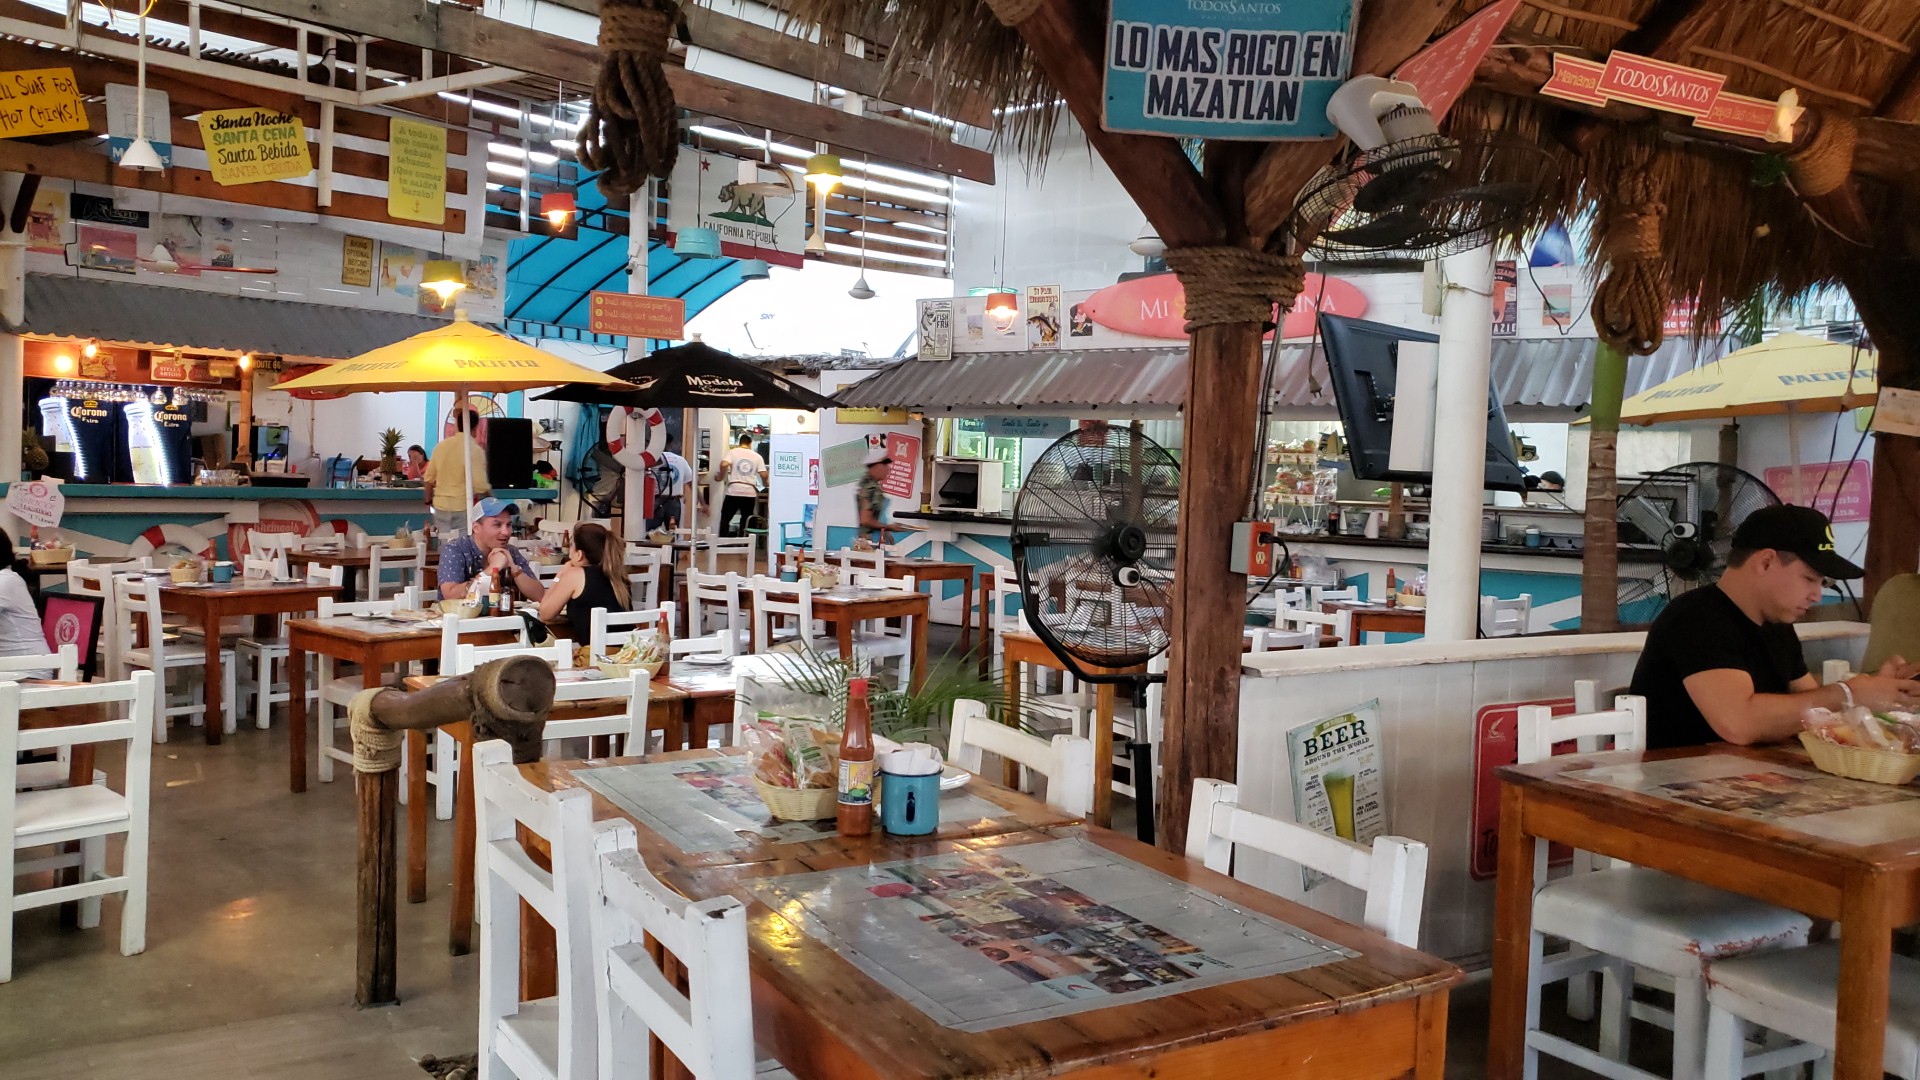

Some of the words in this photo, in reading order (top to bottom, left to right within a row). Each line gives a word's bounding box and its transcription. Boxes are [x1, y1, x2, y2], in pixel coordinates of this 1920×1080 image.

[1114, 24, 1149, 69] LO
[1156, 28, 1221, 75] MAS
[1226, 33, 1297, 77] RICO
[1302, 35, 1343, 77] EN
[1146, 75, 1300, 121] MAZATLAN
[210, 114, 252, 131] Santa
[253, 111, 294, 127] Noche
[212, 129, 259, 146] SANTA
[262, 126, 297, 142] CENA
[217, 147, 257, 165] Santa
[257, 141, 300, 162] Bebida
[221, 165, 260, 179] SANTA
[936, 313, 949, 321] FISH
[1140, 298, 1169, 320] MI
[936, 320, 949, 329] FRY
[453, 359, 540, 369] PACIFICO
[685, 374, 744, 387] Modelo
[70, 406, 108, 418] Corona
[153, 410, 187, 422] Corona
[1302, 719, 1368, 758] BEER
[1304, 752, 1331, 766] AROUND
[1332, 746, 1346, 757] THE
[1347, 737, 1370, 750] WORLD
